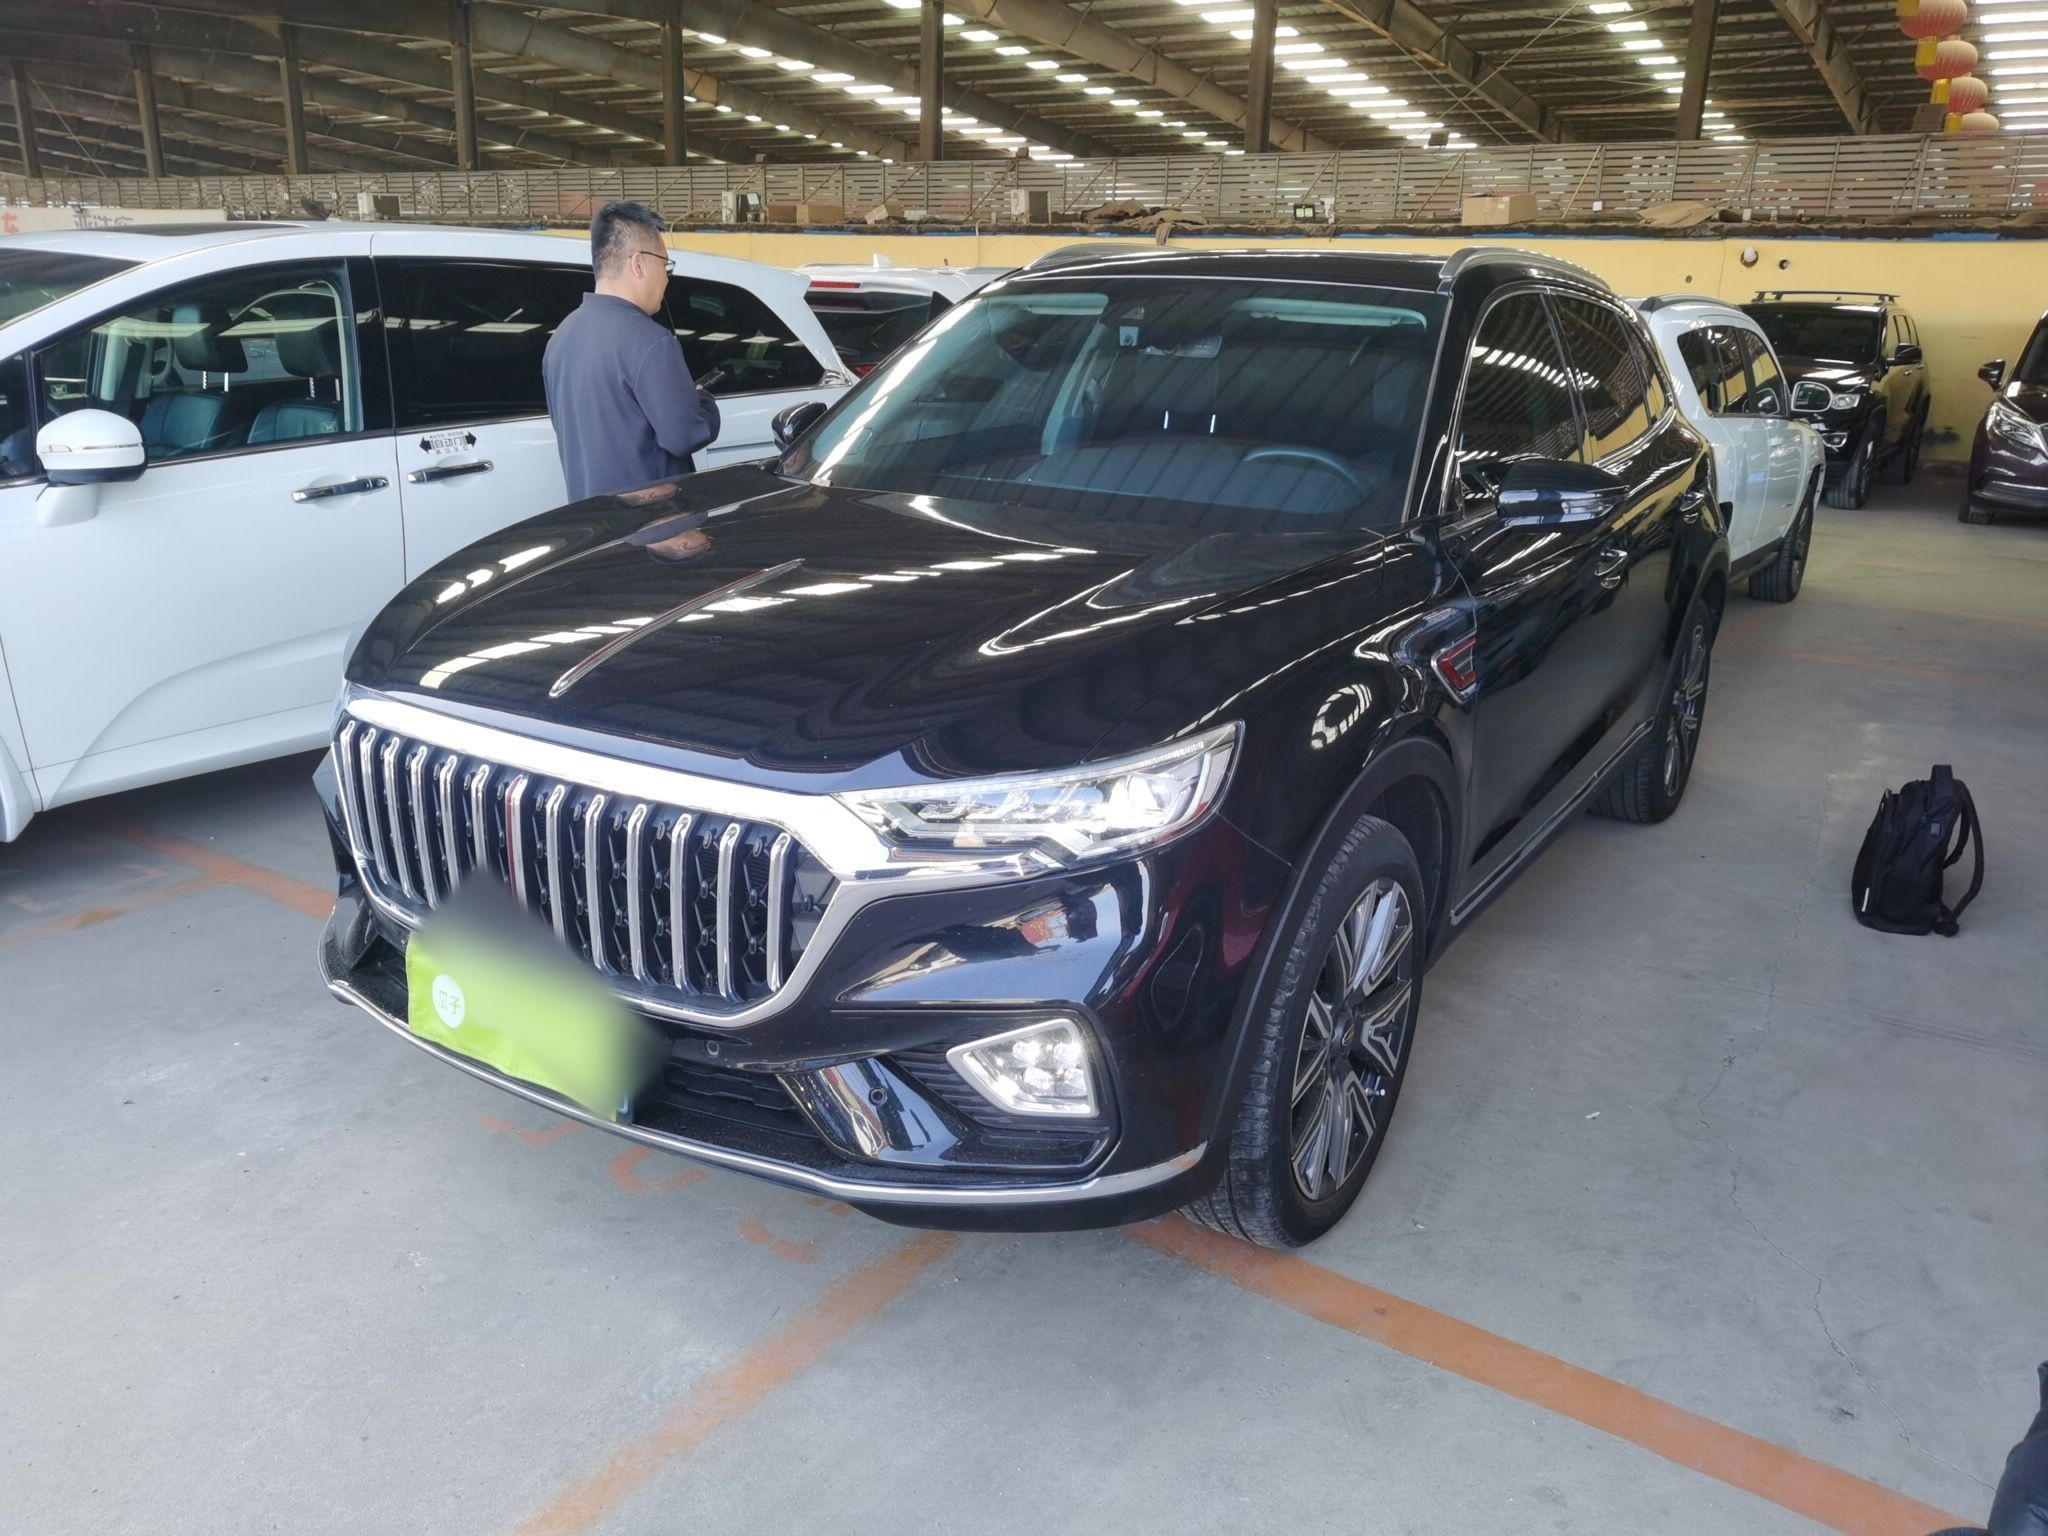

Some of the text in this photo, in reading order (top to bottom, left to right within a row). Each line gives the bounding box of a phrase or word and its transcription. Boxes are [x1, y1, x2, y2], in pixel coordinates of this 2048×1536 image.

[435, 437, 463, 448] 自动门
[438, 990, 461, 1014] 瓜子
